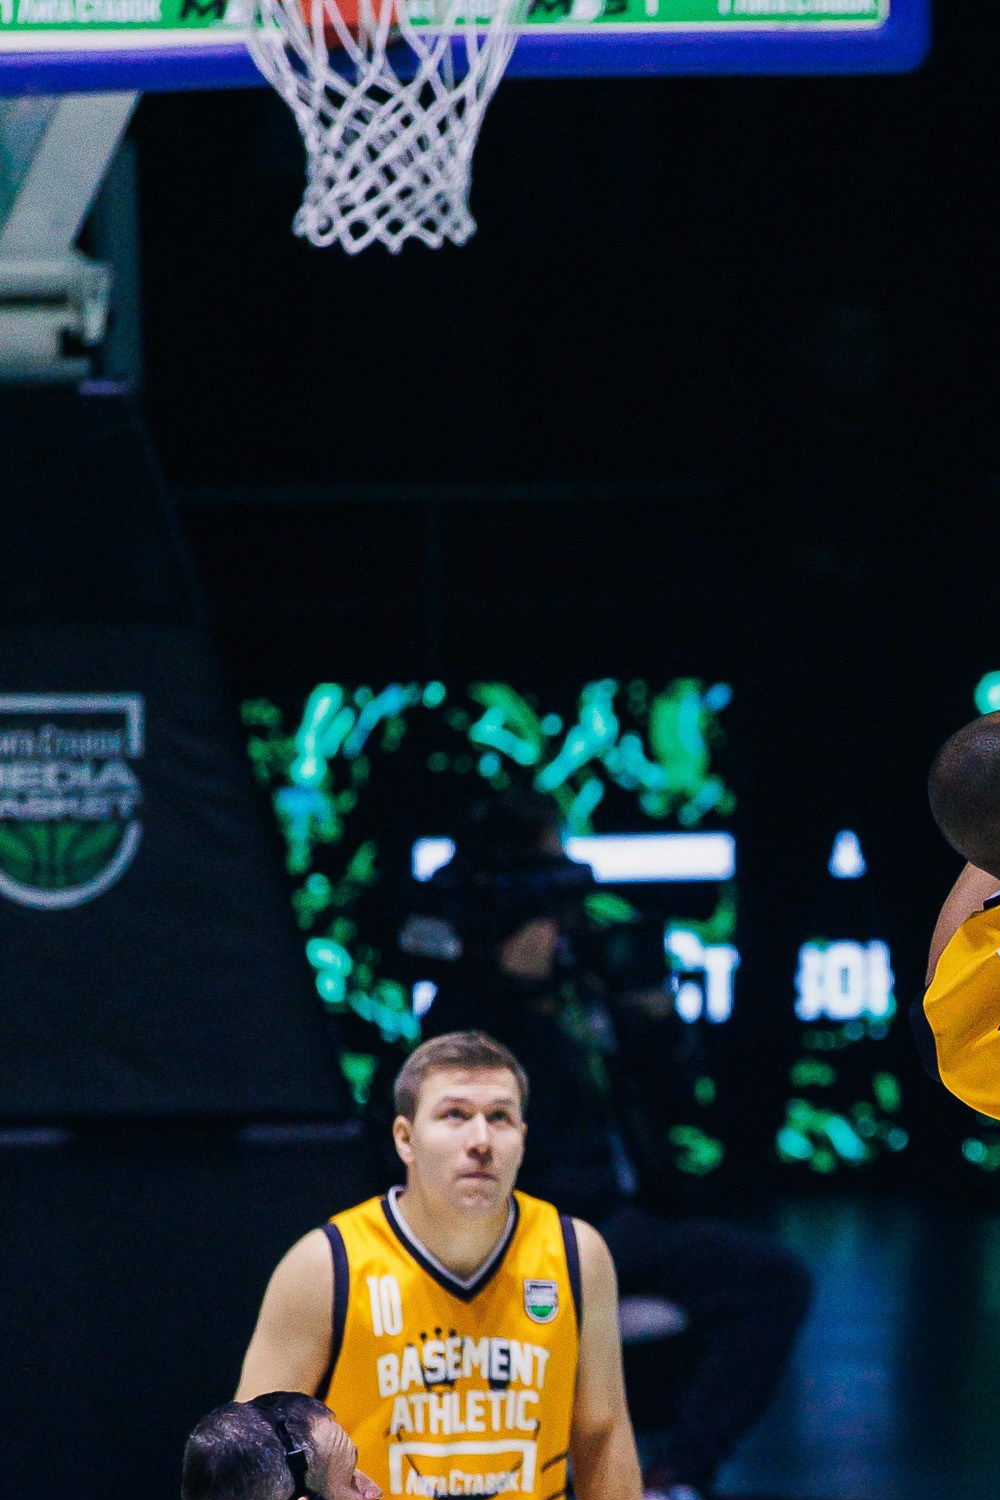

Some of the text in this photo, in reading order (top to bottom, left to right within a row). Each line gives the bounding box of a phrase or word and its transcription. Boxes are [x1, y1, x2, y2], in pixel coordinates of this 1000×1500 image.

[366, 1274, 404, 1338] 10
[376, 1335, 551, 1399] BASEMENT
[388, 1388, 541, 1436] ATHLETIC
